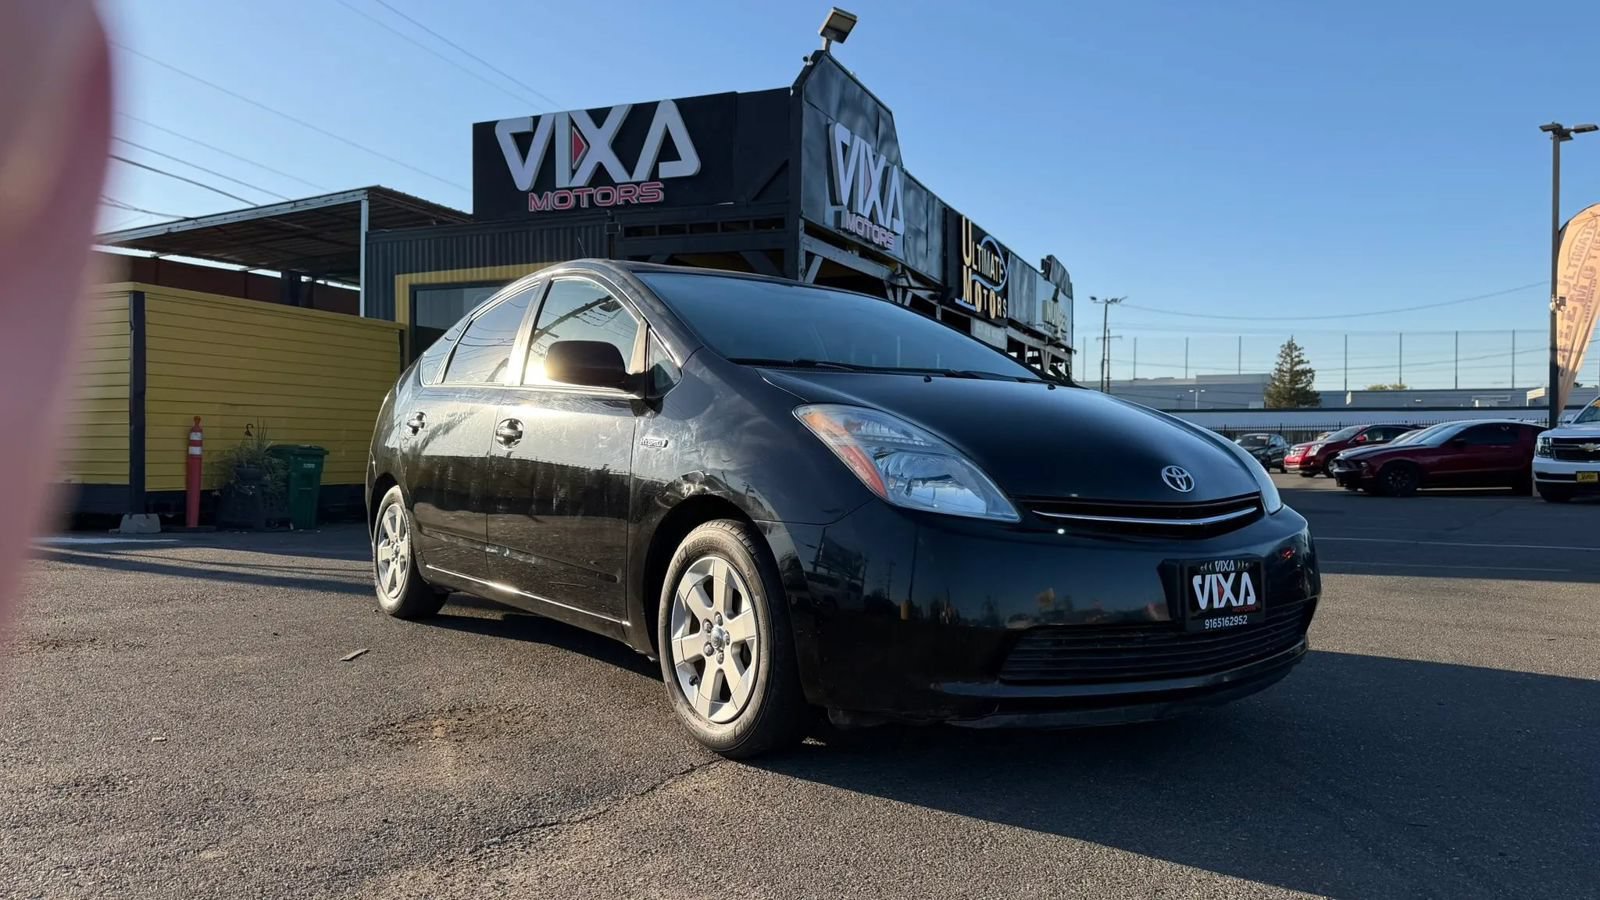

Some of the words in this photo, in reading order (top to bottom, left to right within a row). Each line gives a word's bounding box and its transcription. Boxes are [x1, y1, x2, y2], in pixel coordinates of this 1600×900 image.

[495, 98, 701, 192] VIXA
[528, 181, 665, 213] MOTORS
[830, 121, 905, 236] VIXA
[846, 210, 895, 250] MOTORS
[962, 264, 1008, 320] MOTORS
[1214, 559, 1235, 573] VIXA
[1192, 571, 1257, 611] VIXA
[1204, 614, 1248, 630] 9165162952
